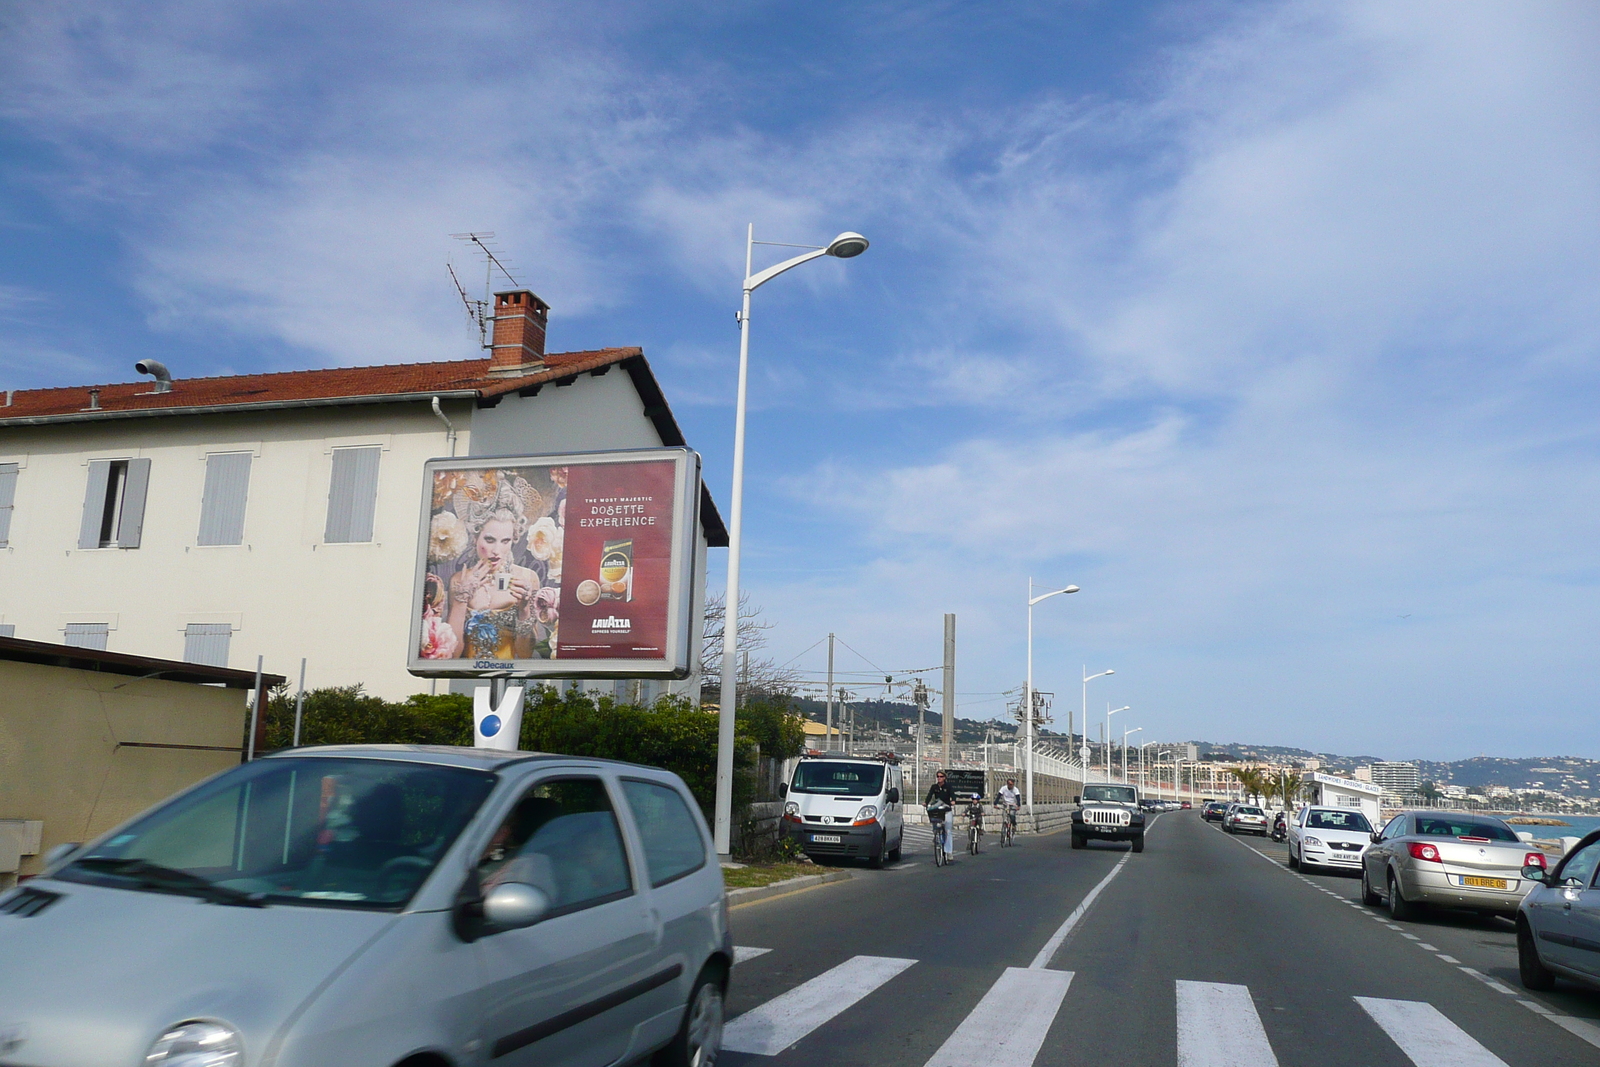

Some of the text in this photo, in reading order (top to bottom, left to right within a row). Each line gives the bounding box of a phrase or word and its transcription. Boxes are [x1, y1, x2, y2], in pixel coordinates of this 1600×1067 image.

[591, 504, 644, 516] DOSETTE
[580, 516, 655, 528] EXPERIENCE
[591, 615, 631, 628] LAVAZZA
[473, 660, 514, 669] JCDecaux
[1318, 774, 1380, 792] SANDWICHES BOISSONS GLACES
